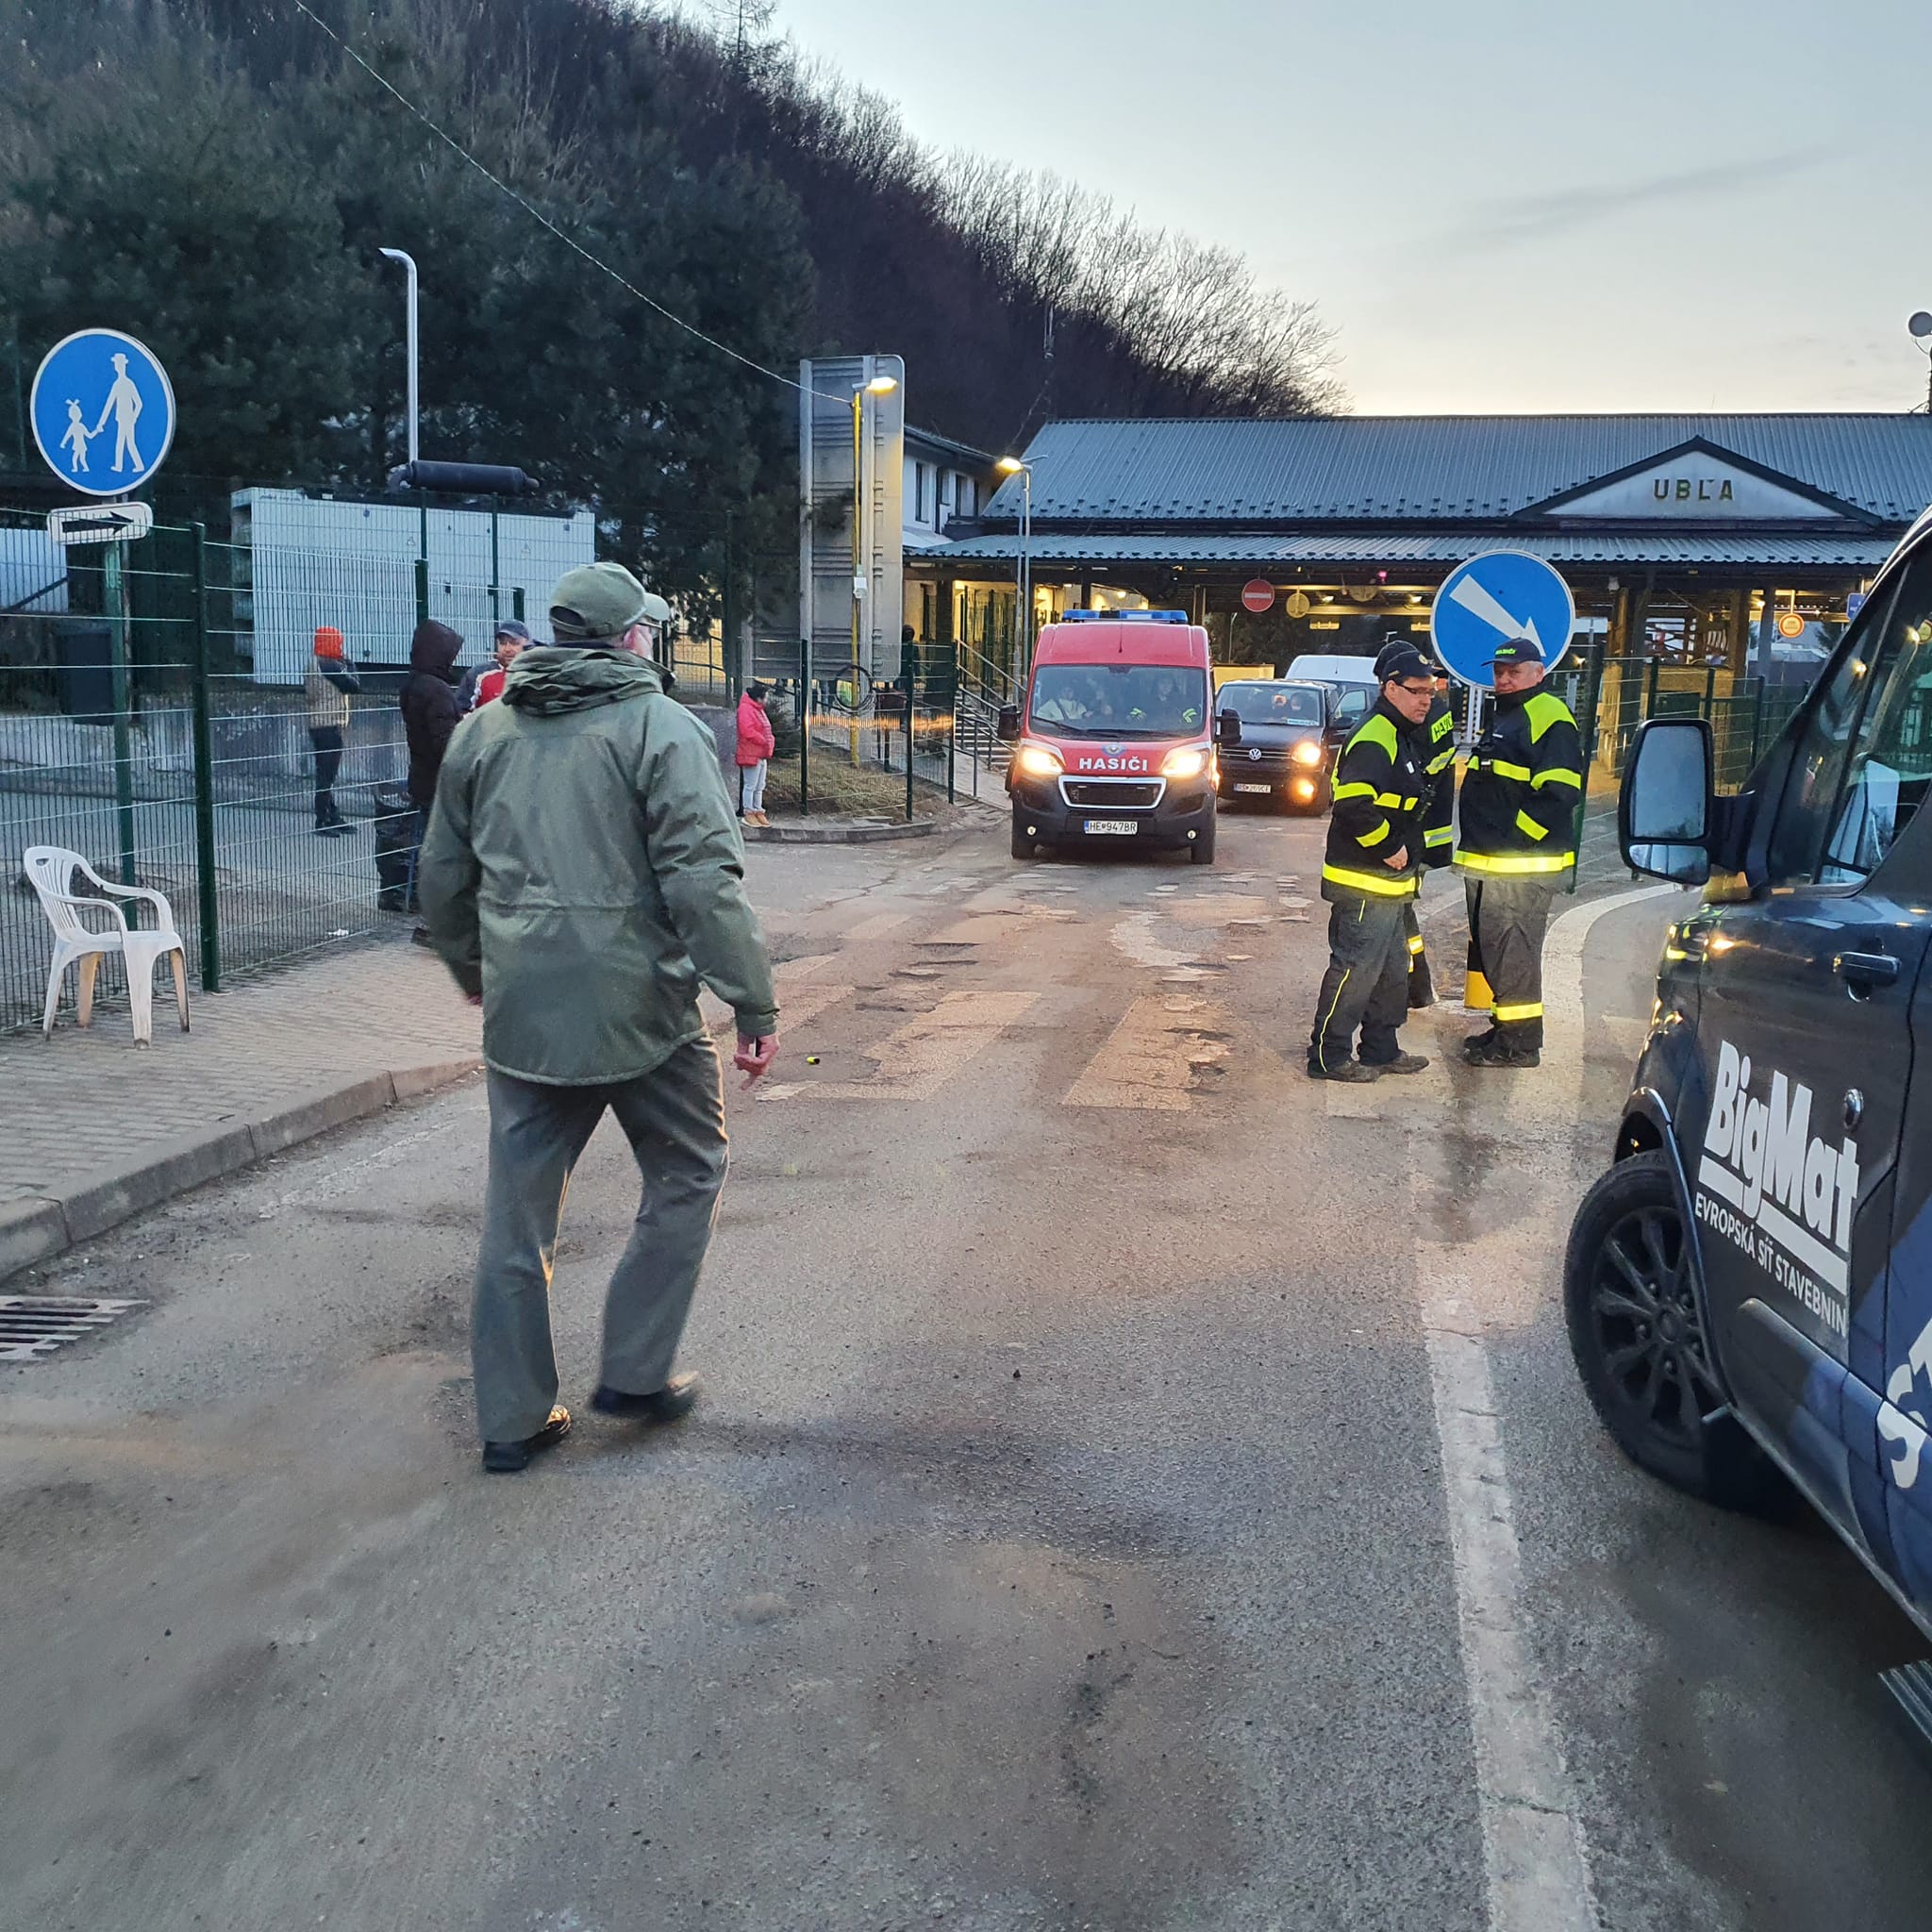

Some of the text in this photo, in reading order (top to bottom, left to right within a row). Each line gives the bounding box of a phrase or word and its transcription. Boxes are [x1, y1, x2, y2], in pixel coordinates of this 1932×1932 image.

[1078, 756, 1148, 772] HASIČI
[1704, 1040, 1860, 1253] BigMat
[1694, 1191, 1757, 1259] EVROPSKÁ
